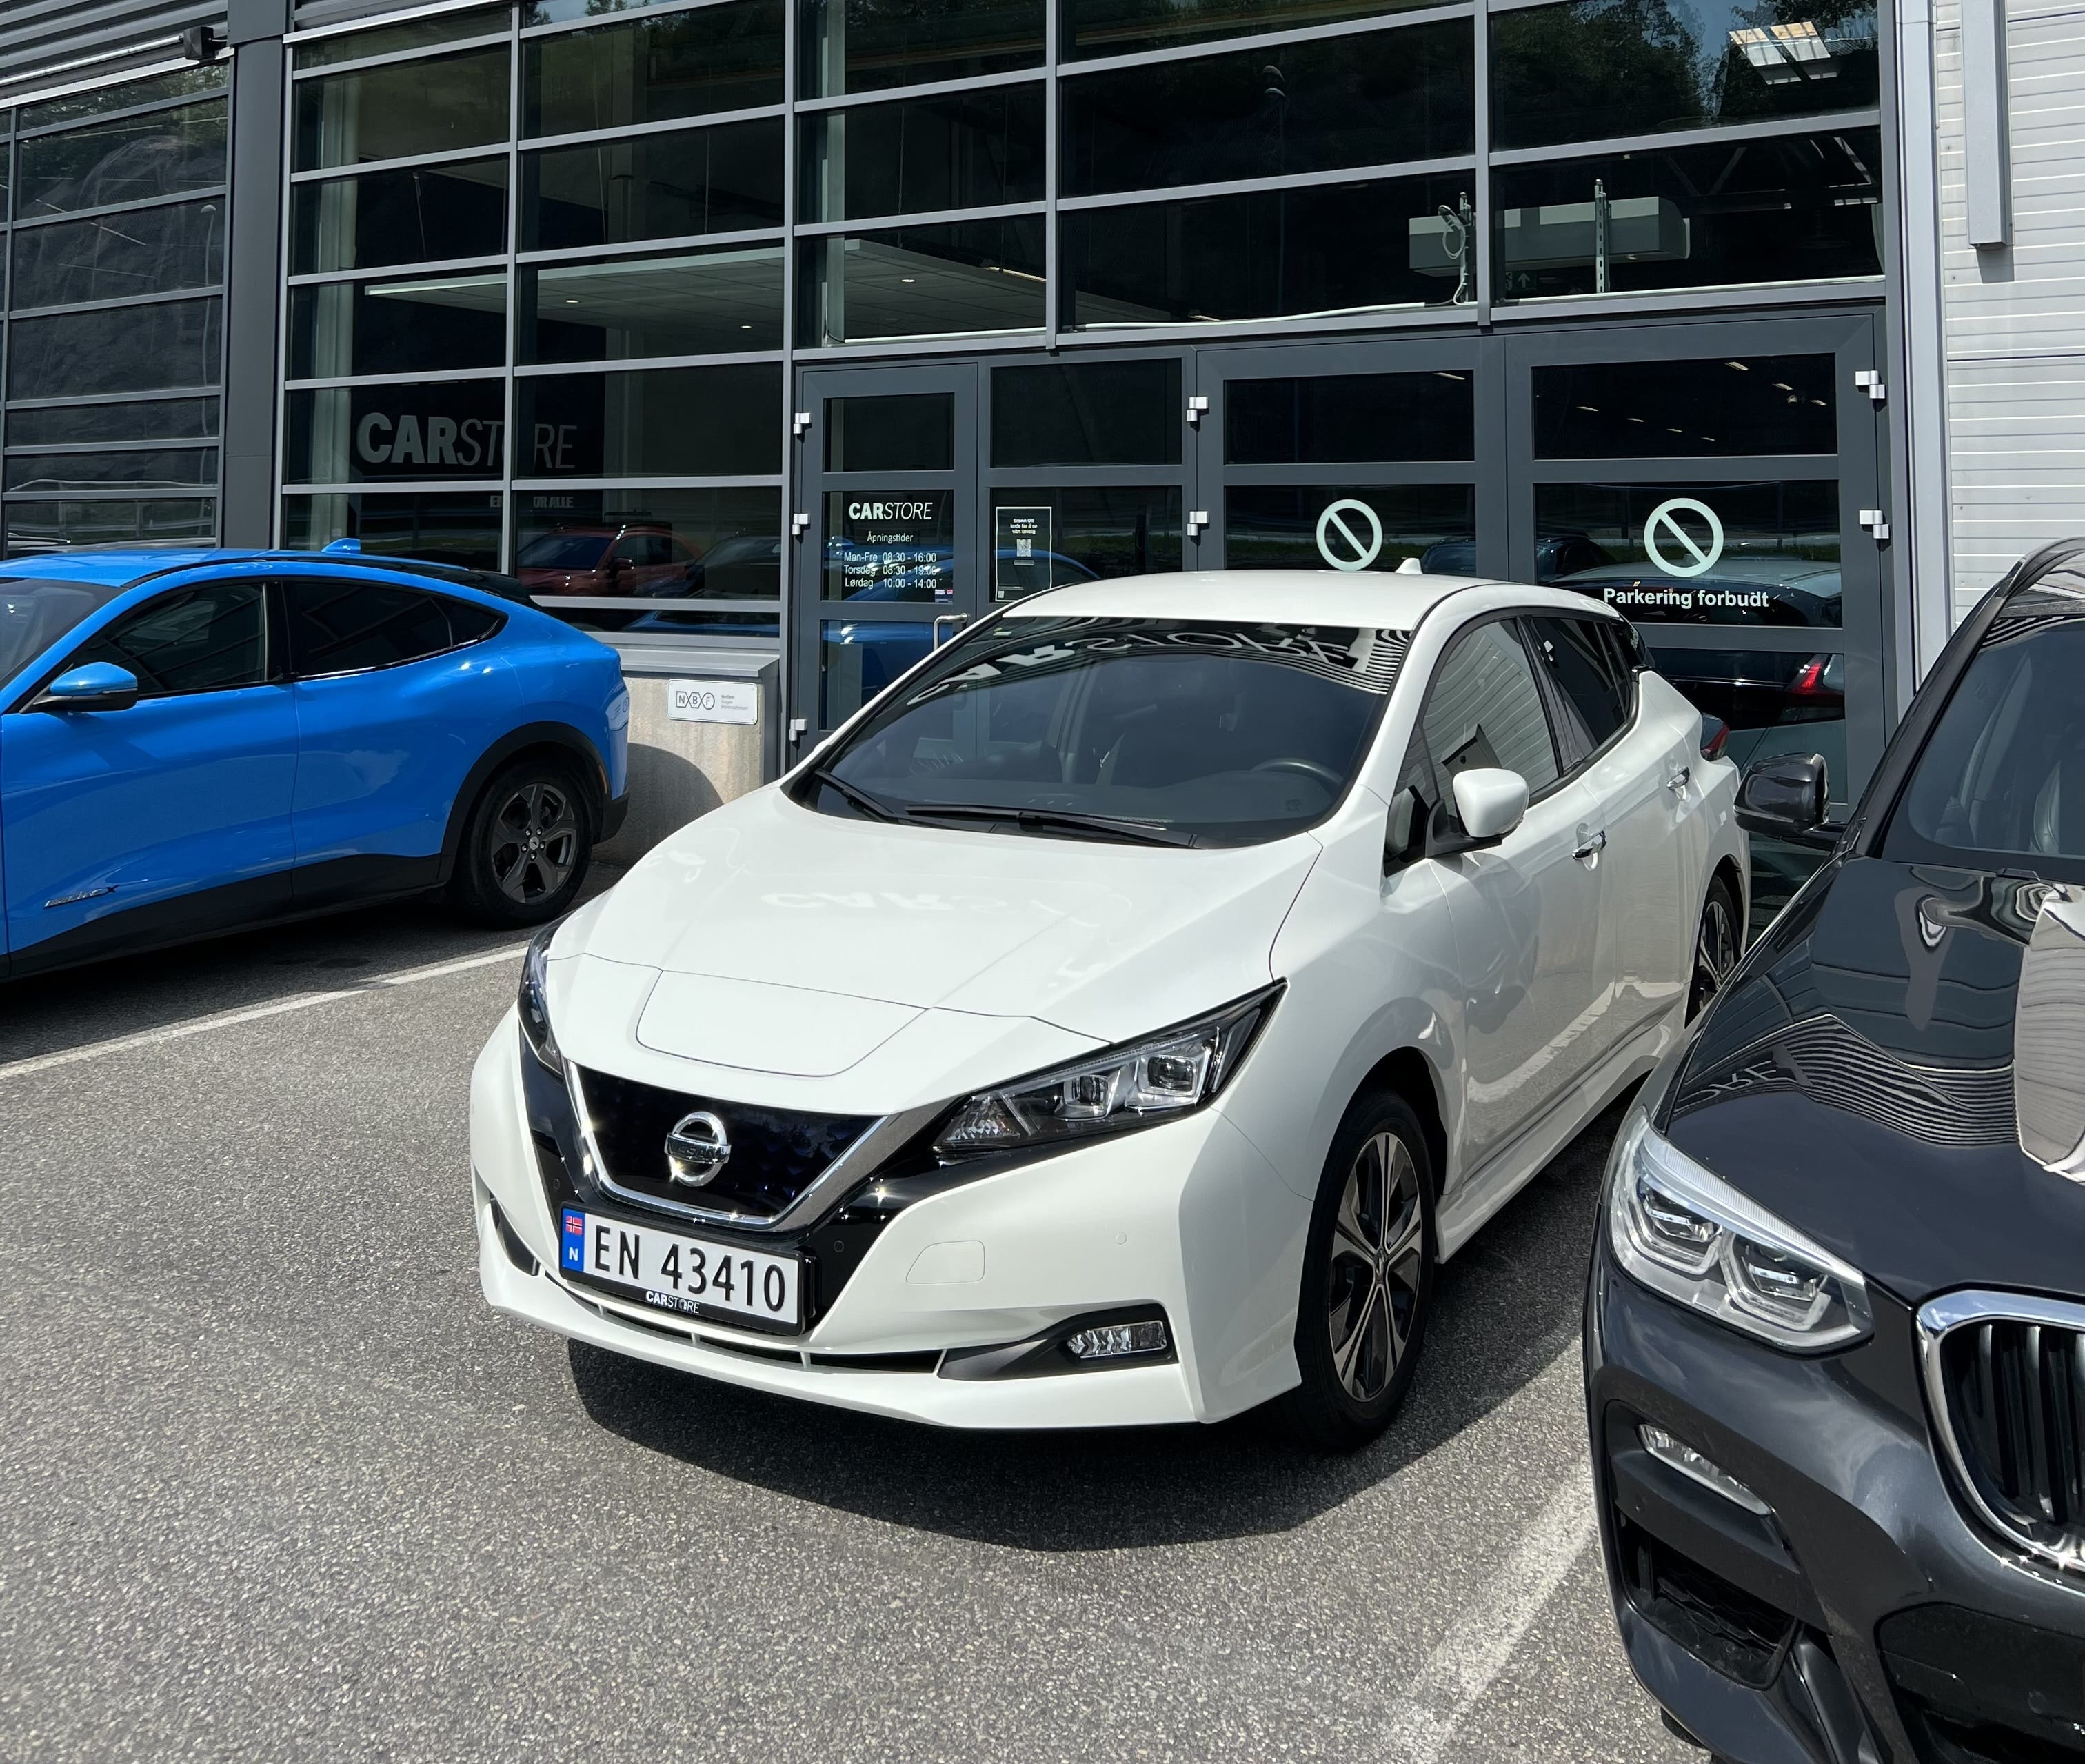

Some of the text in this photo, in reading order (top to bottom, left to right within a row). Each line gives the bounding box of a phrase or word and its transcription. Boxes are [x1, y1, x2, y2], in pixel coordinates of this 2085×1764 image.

[356, 412, 578, 470] CARSTRE
[849, 502, 933, 519] CARSTORE
[867, 531, 914, 543] Åpningstider
[844, 552, 878, 562] Man-Fre
[883, 552, 906, 562] 08:30
[914, 552, 937, 563] 16:00
[844, 565, 876, 577] Torsdag
[883, 565, 906, 575] 08:30
[845, 578, 874, 589] Lørdag
[883, 579, 906, 588] 10:00
[914, 579, 937, 589] 14:00
[1604, 588, 1769, 609] Parkering forbudt
[569, 1247, 578, 1261] N
[595, 1225, 785, 1312] EN 43410
[646, 1290, 700, 1314] CARSTORE
